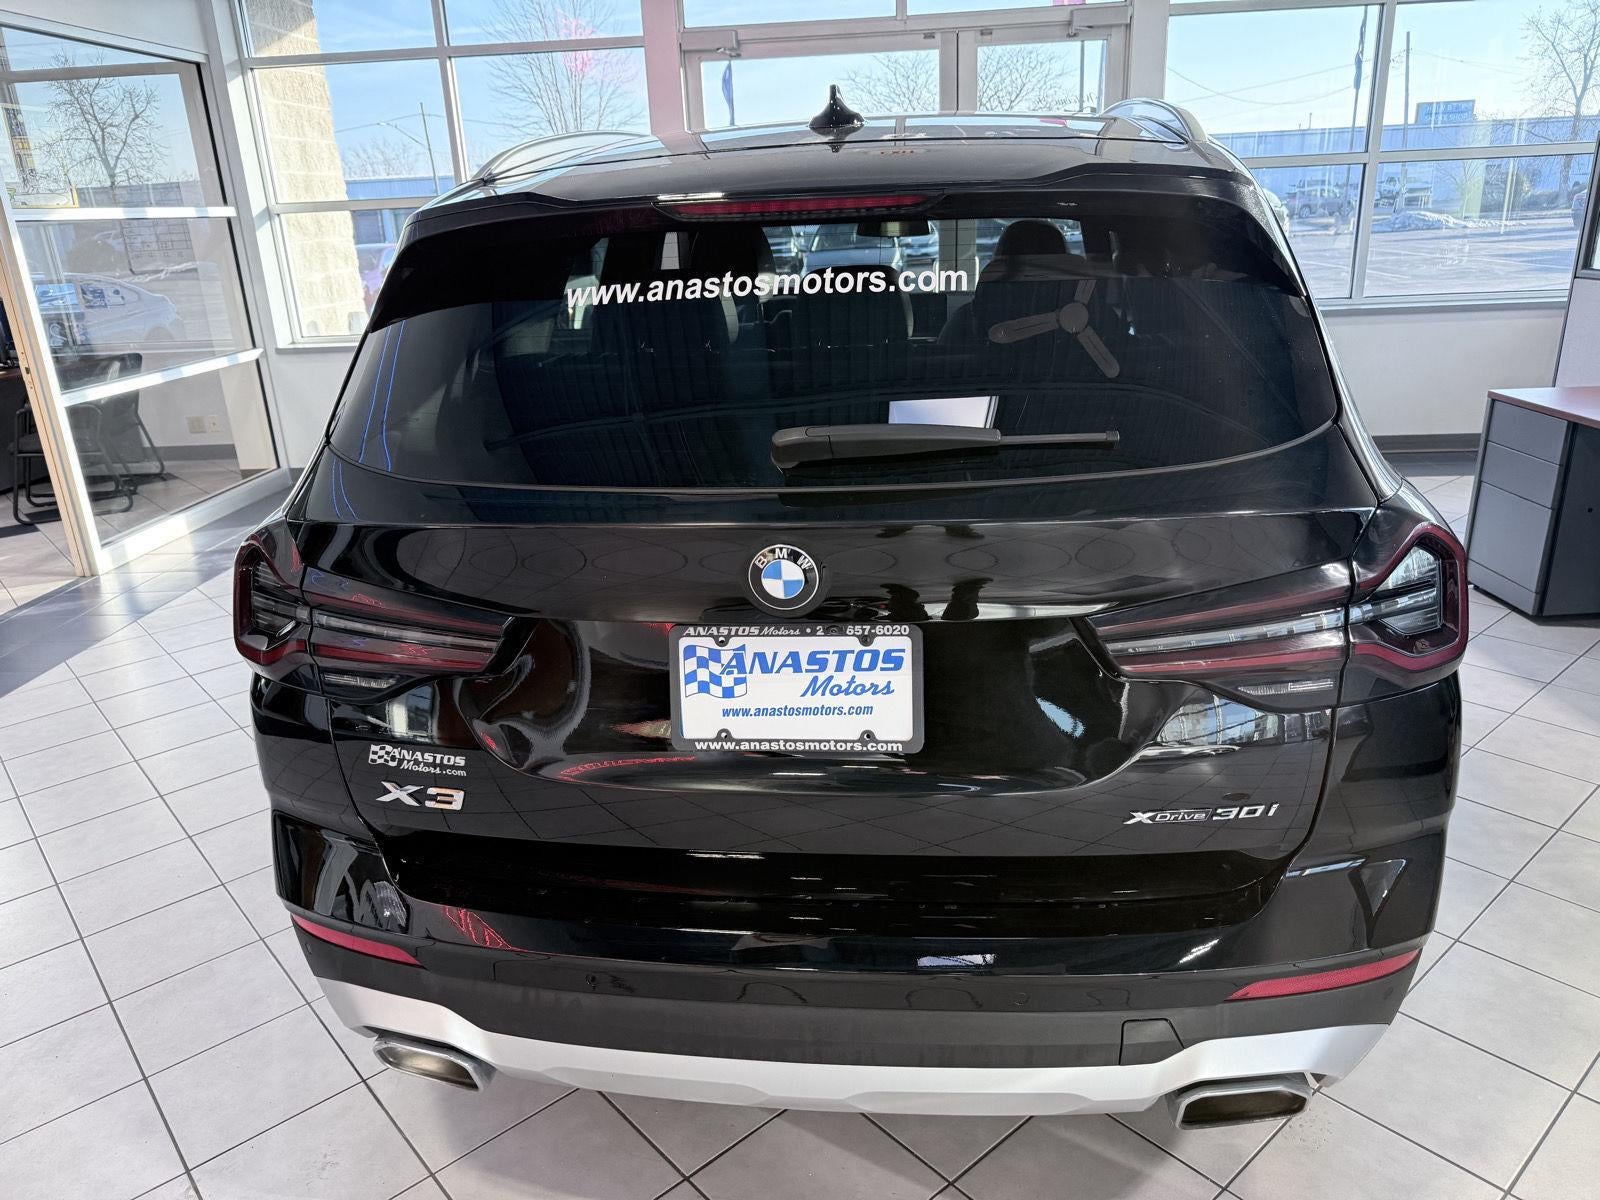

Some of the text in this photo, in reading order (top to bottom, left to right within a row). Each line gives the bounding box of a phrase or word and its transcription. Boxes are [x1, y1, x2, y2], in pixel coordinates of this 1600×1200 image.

[566, 266, 968, 308] www.anastosmotors.com
[754, 547, 815, 570] BMW
[683, 626, 760, 636] ANASTOS
[760, 626, 801, 636] Motors
[846, 625, 910, 635] 657-6020
[720, 648, 905, 676] ANASTOS
[800, 675, 895, 697] Motors
[722, 704, 874, 718] www.anastosmotors.com
[695, 739, 903, 751] www.anastosmotors.com
[389, 747, 466, 767] ANASTOS
[375, 780, 465, 811] X3
